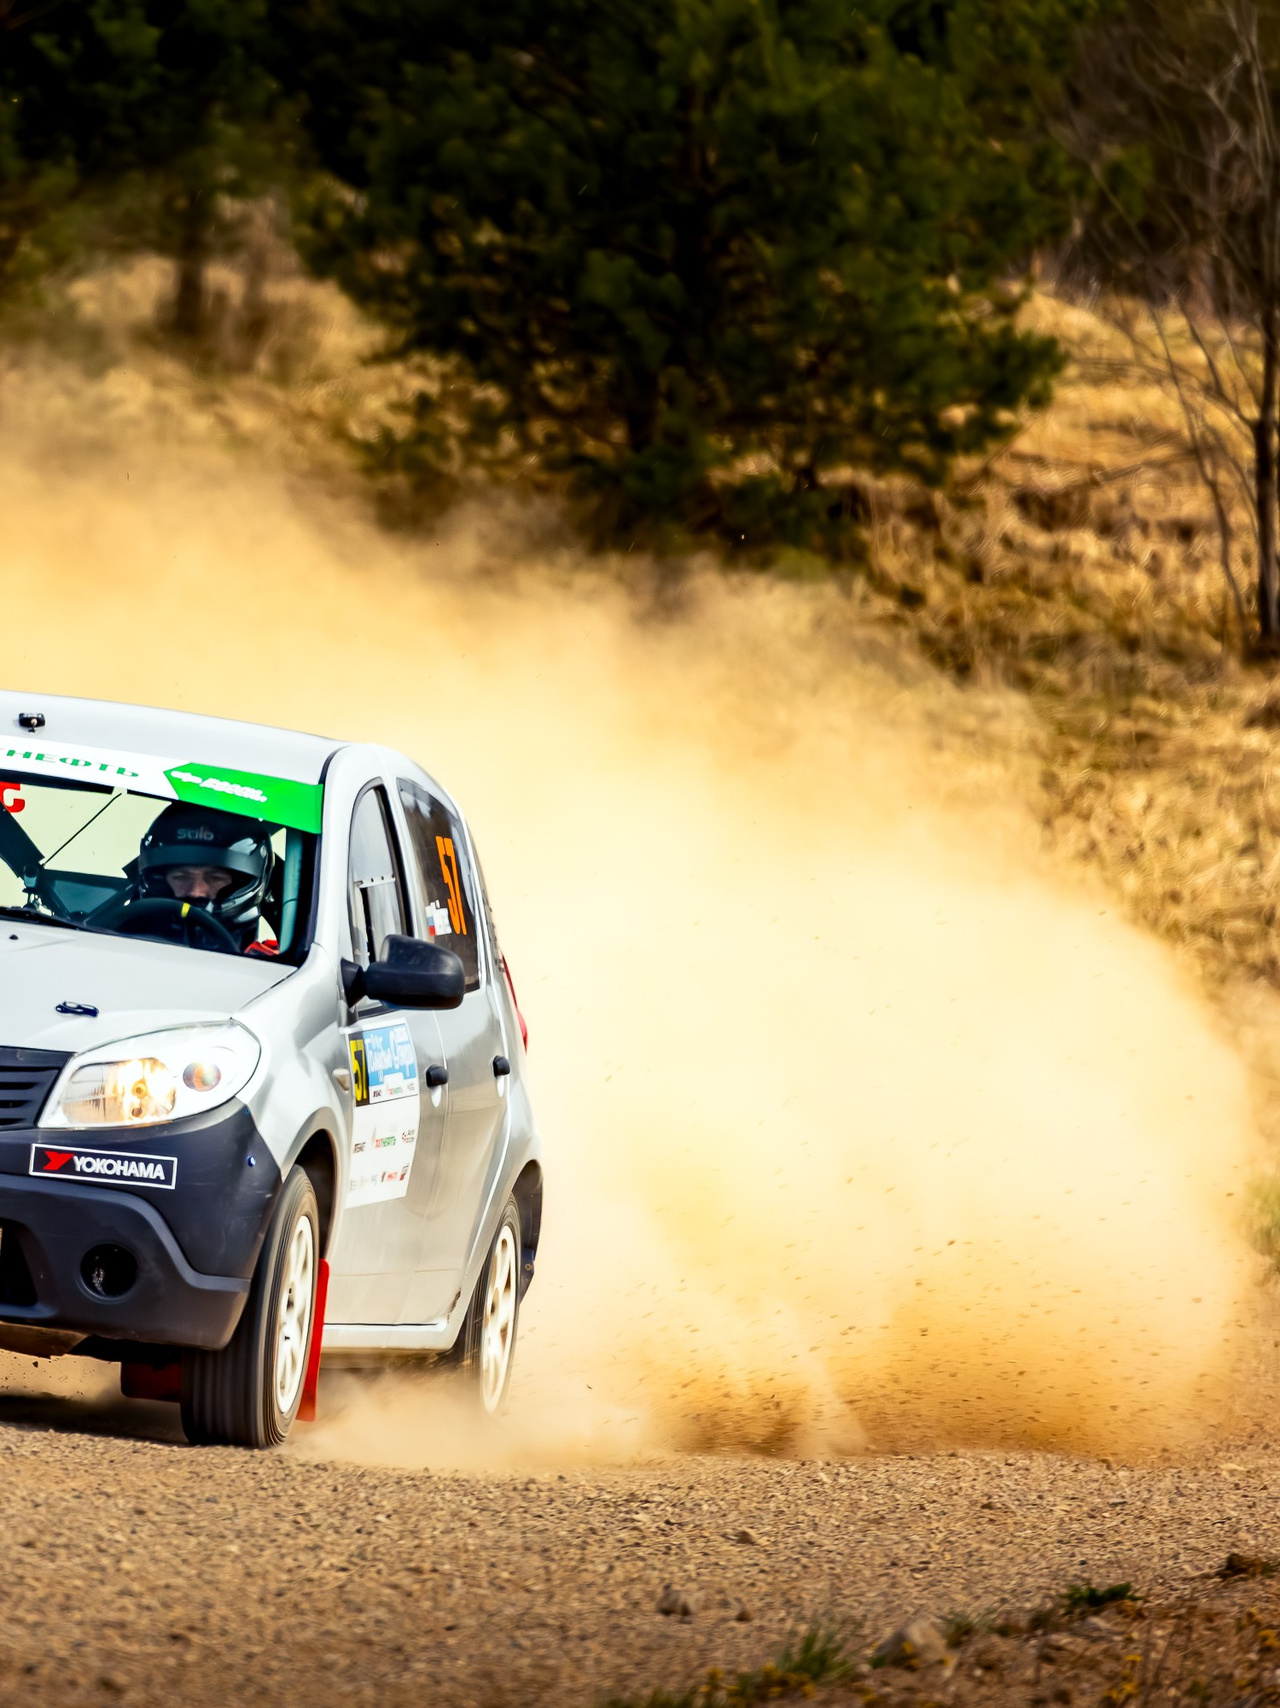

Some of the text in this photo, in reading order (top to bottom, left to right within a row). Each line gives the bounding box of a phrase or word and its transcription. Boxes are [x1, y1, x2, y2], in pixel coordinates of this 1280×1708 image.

[435, 836, 467, 935] 57
[350, 1039, 367, 1101] 57
[73, 1156, 165, 1180] YOKOHAMA
